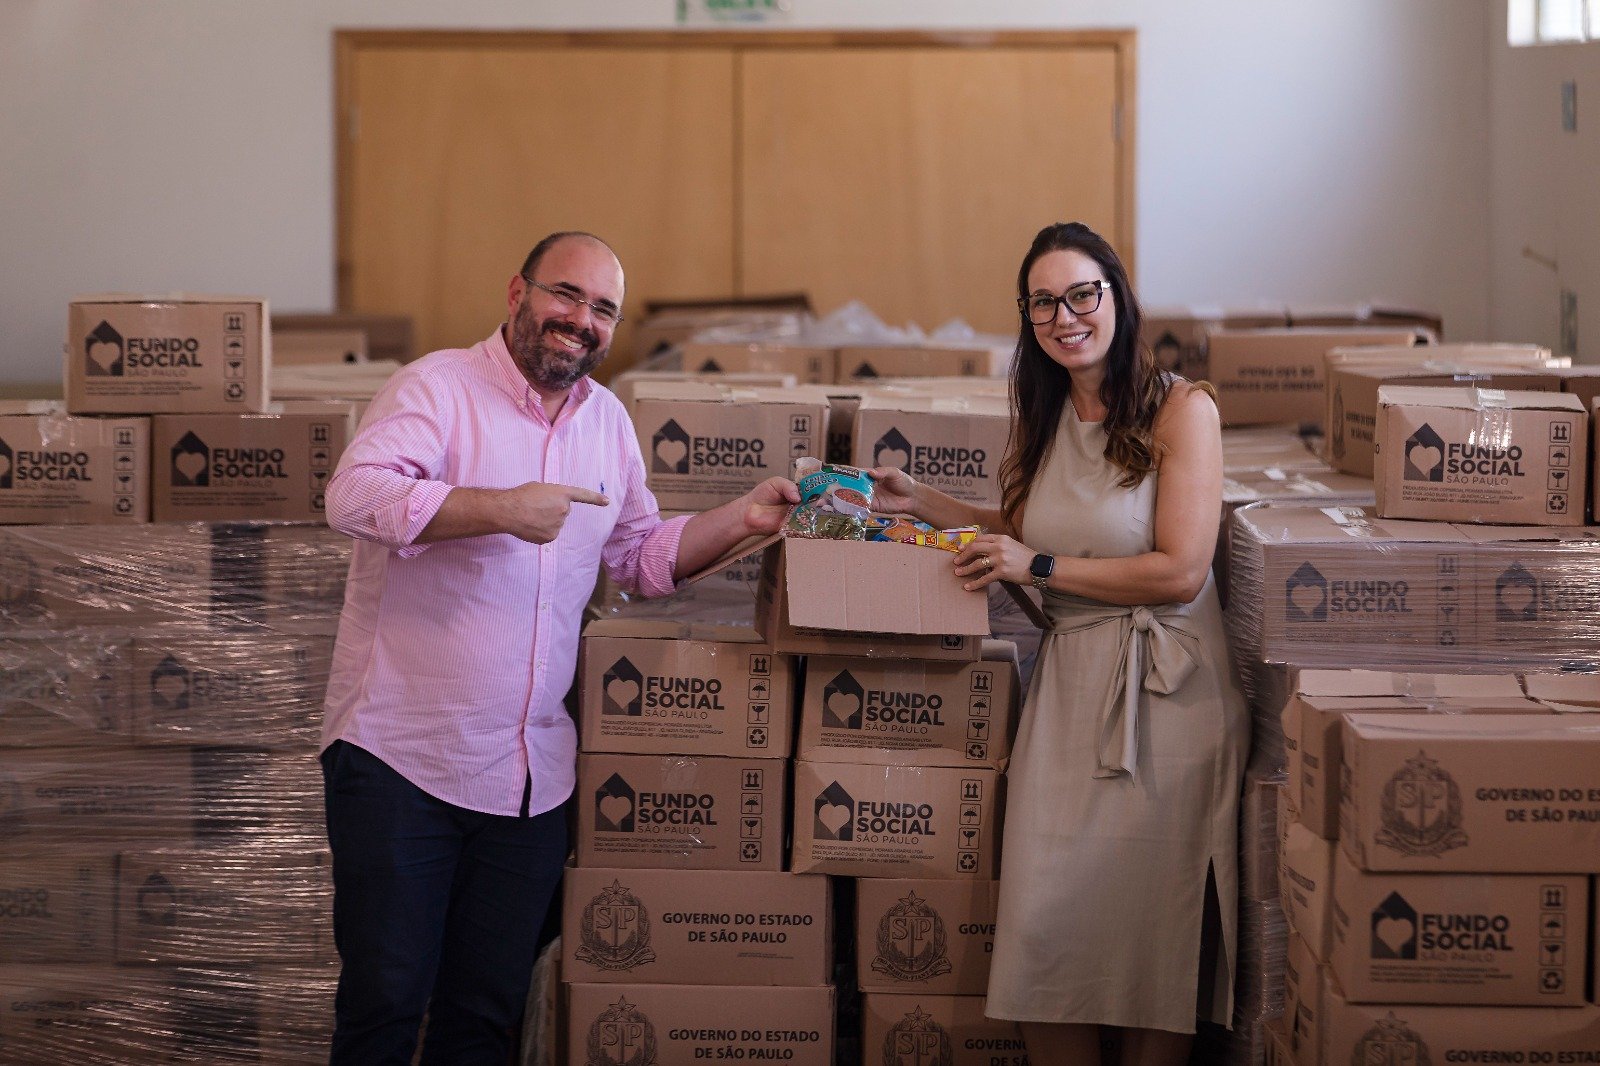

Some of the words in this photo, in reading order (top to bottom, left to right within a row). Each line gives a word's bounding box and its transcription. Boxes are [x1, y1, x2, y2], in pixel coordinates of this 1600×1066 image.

[127, 338, 199, 353] FUNDO
[127, 352, 202, 368] SOCIAL
[693, 437, 765, 453] FUNDO
[1448, 443, 1523, 461] FUNDO
[16, 451, 90, 466] FUNDO
[212, 449, 285, 464] FUNDO
[693, 452, 767, 469] SOCIAL
[914, 446, 986, 463] FUNDO
[16, 466, 92, 481] SOCIAL
[212, 463, 288, 479] SOCIAL
[913, 461, 988, 478] SOCIAL
[1447, 459, 1525, 477] SOCIAL
[915, 475, 934, 487] ÃO
[1446, 473, 1469, 485] SÃO
[1472, 476, 1509, 486] PAULO
[1329, 581, 1410, 598] FUNDO
[1329, 597, 1413, 614] SOCIAL
[646, 676, 722, 694] FUNDO
[645, 692, 725, 711] SOCIAL
[866, 690, 943, 709] FUNDO
[644, 707, 667, 719] SÃO
[671, 709, 708, 720] PAULO
[866, 706, 945, 726] SOCIAL
[864, 722, 888, 732] SÃO
[891, 724, 928, 735] PAULO
[639, 792, 714, 809] FUNDO
[1476, 788, 1555, 801] GOVERNO
[1559, 788, 1583, 801] DO
[638, 808, 717, 826] SOCIAL
[857, 801, 933, 820] FUNDO
[1506, 809, 1528, 822] DE
[1531, 806, 1564, 823] SÃO
[1567, 810, 1600, 823] PAU
[637, 823, 660, 834] SÃO
[664, 825, 701, 835] PAULO
[856, 817, 936, 836] SOCIAL
[855, 832, 879, 844] SÃO
[882, 834, 919, 845] PAULO
[662, 912, 731, 926] GOVERNO
[734, 912, 756, 926] DO
[759, 912, 813, 926] ESTADO
[1421, 914, 1509, 932] FUNDO
[687, 930, 708, 943] DE
[710, 926, 739, 943] SÃO
[742, 930, 787, 943] PAULO
[958, 923, 997, 936] GOVE
[984, 942, 994, 953] D
[1421, 932, 1513, 951] SOCIAL
[669, 1028, 738, 1042] GOVERNO
[740, 1029, 762, 1042] DO
[765, 1029, 820, 1043] ESTADO
[694, 1047, 715, 1060] DE
[717, 1043, 746, 1060] SÃO
[749, 1047, 794, 1061] PAULO
[1013, 1053, 1032, 1066] SÃ
[1445, 1049, 1525, 1064] GOVERNO
[1528, 1051, 1553, 1064] DO
[1557, 1051, 1600, 1064] ESTA
